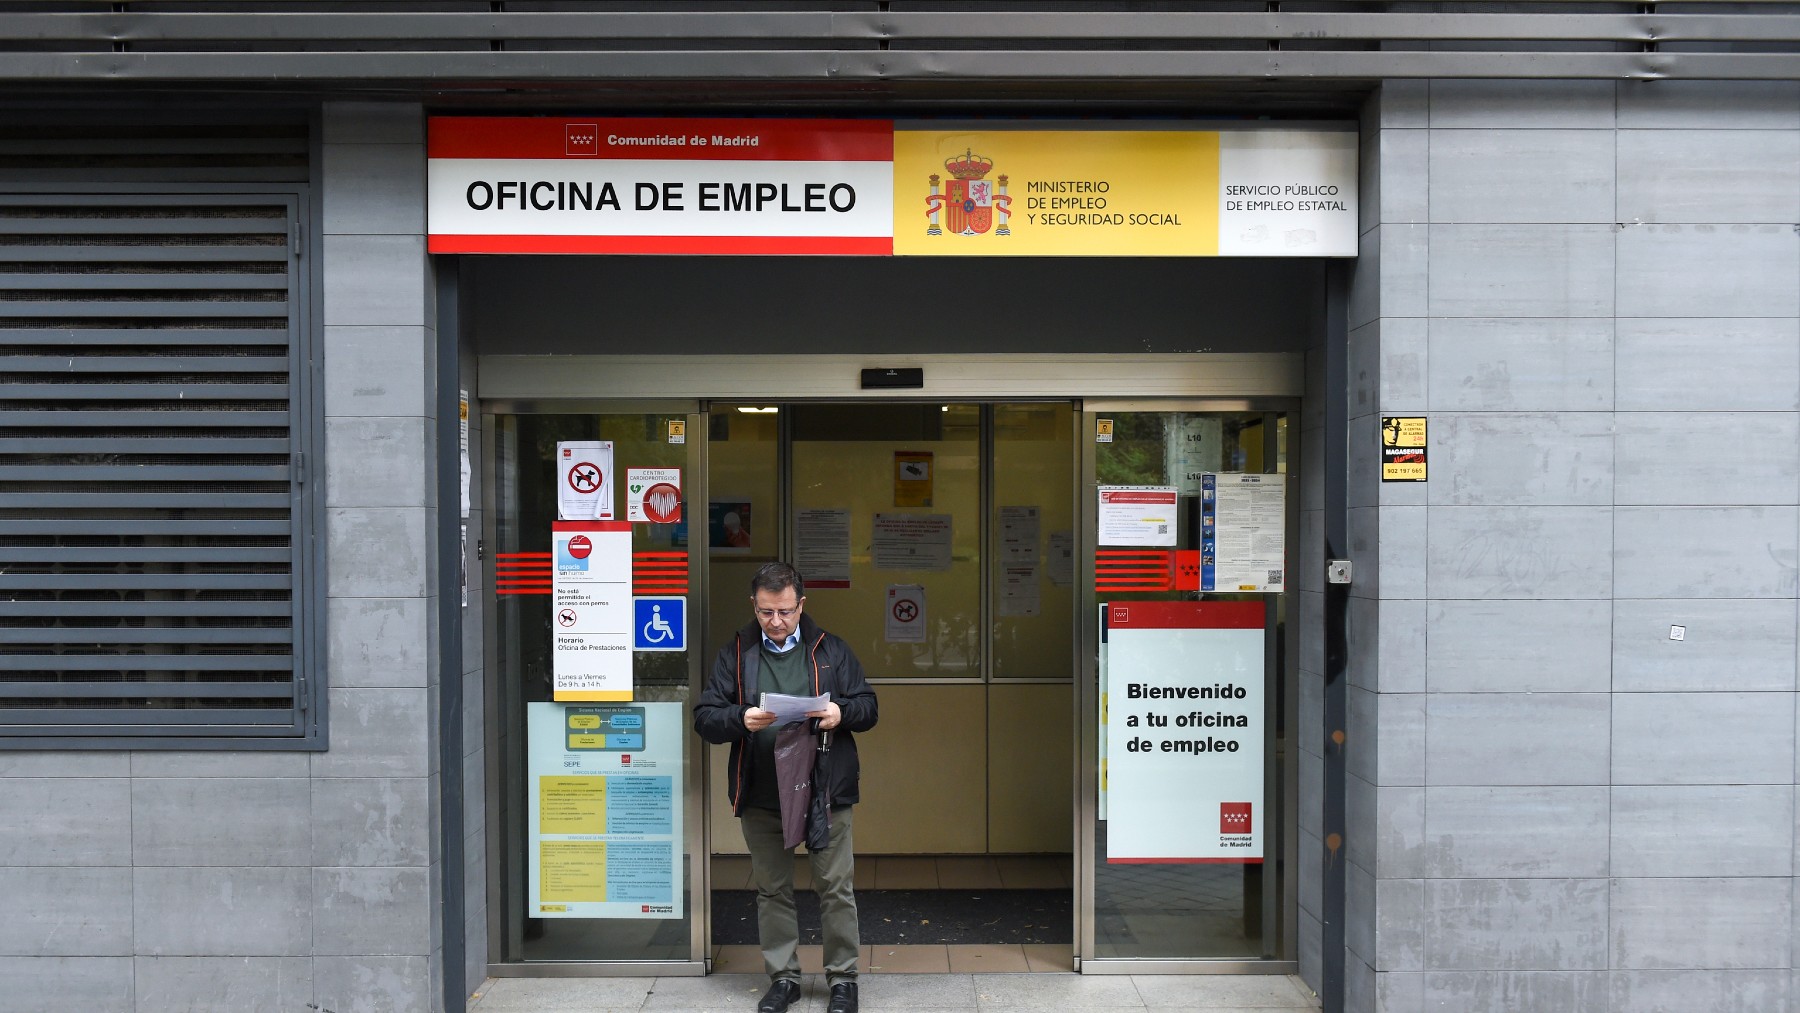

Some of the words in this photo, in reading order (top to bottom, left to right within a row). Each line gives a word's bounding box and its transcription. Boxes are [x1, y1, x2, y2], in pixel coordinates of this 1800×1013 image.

[606, 134, 686, 147] Comunidad
[689, 134, 707, 147] de
[712, 134, 759, 147] Madrid
[1027, 181, 1110, 194] MINISTERIO
[1226, 184, 1281, 196] SERVICIO
[1284, 182, 1339, 196] PÚBLICO
[466, 180, 621, 211] OFICINA
[634, 182, 684, 212] DE
[698, 182, 857, 213] EMPLEO
[1027, 197, 1048, 210] DE
[1051, 197, 1108, 210] EMPLEO
[1226, 200, 1244, 212] DE
[1246, 200, 1295, 212] EMPLEO
[1298, 200, 1348, 212] ESTATAL
[1027, 214, 1036, 226] Y
[1040, 213, 1124, 226] SEGURIDAD
[1128, 214, 1182, 226] SOCIAL
[1128, 683, 1247, 699] Bienvenido
[1126, 716, 1139, 728] a
[1146, 712, 1168, 728] tu
[1175, 712, 1248, 728] oficina
[1126, 736, 1153, 752] de
[1160, 736, 1240, 755] empleo
